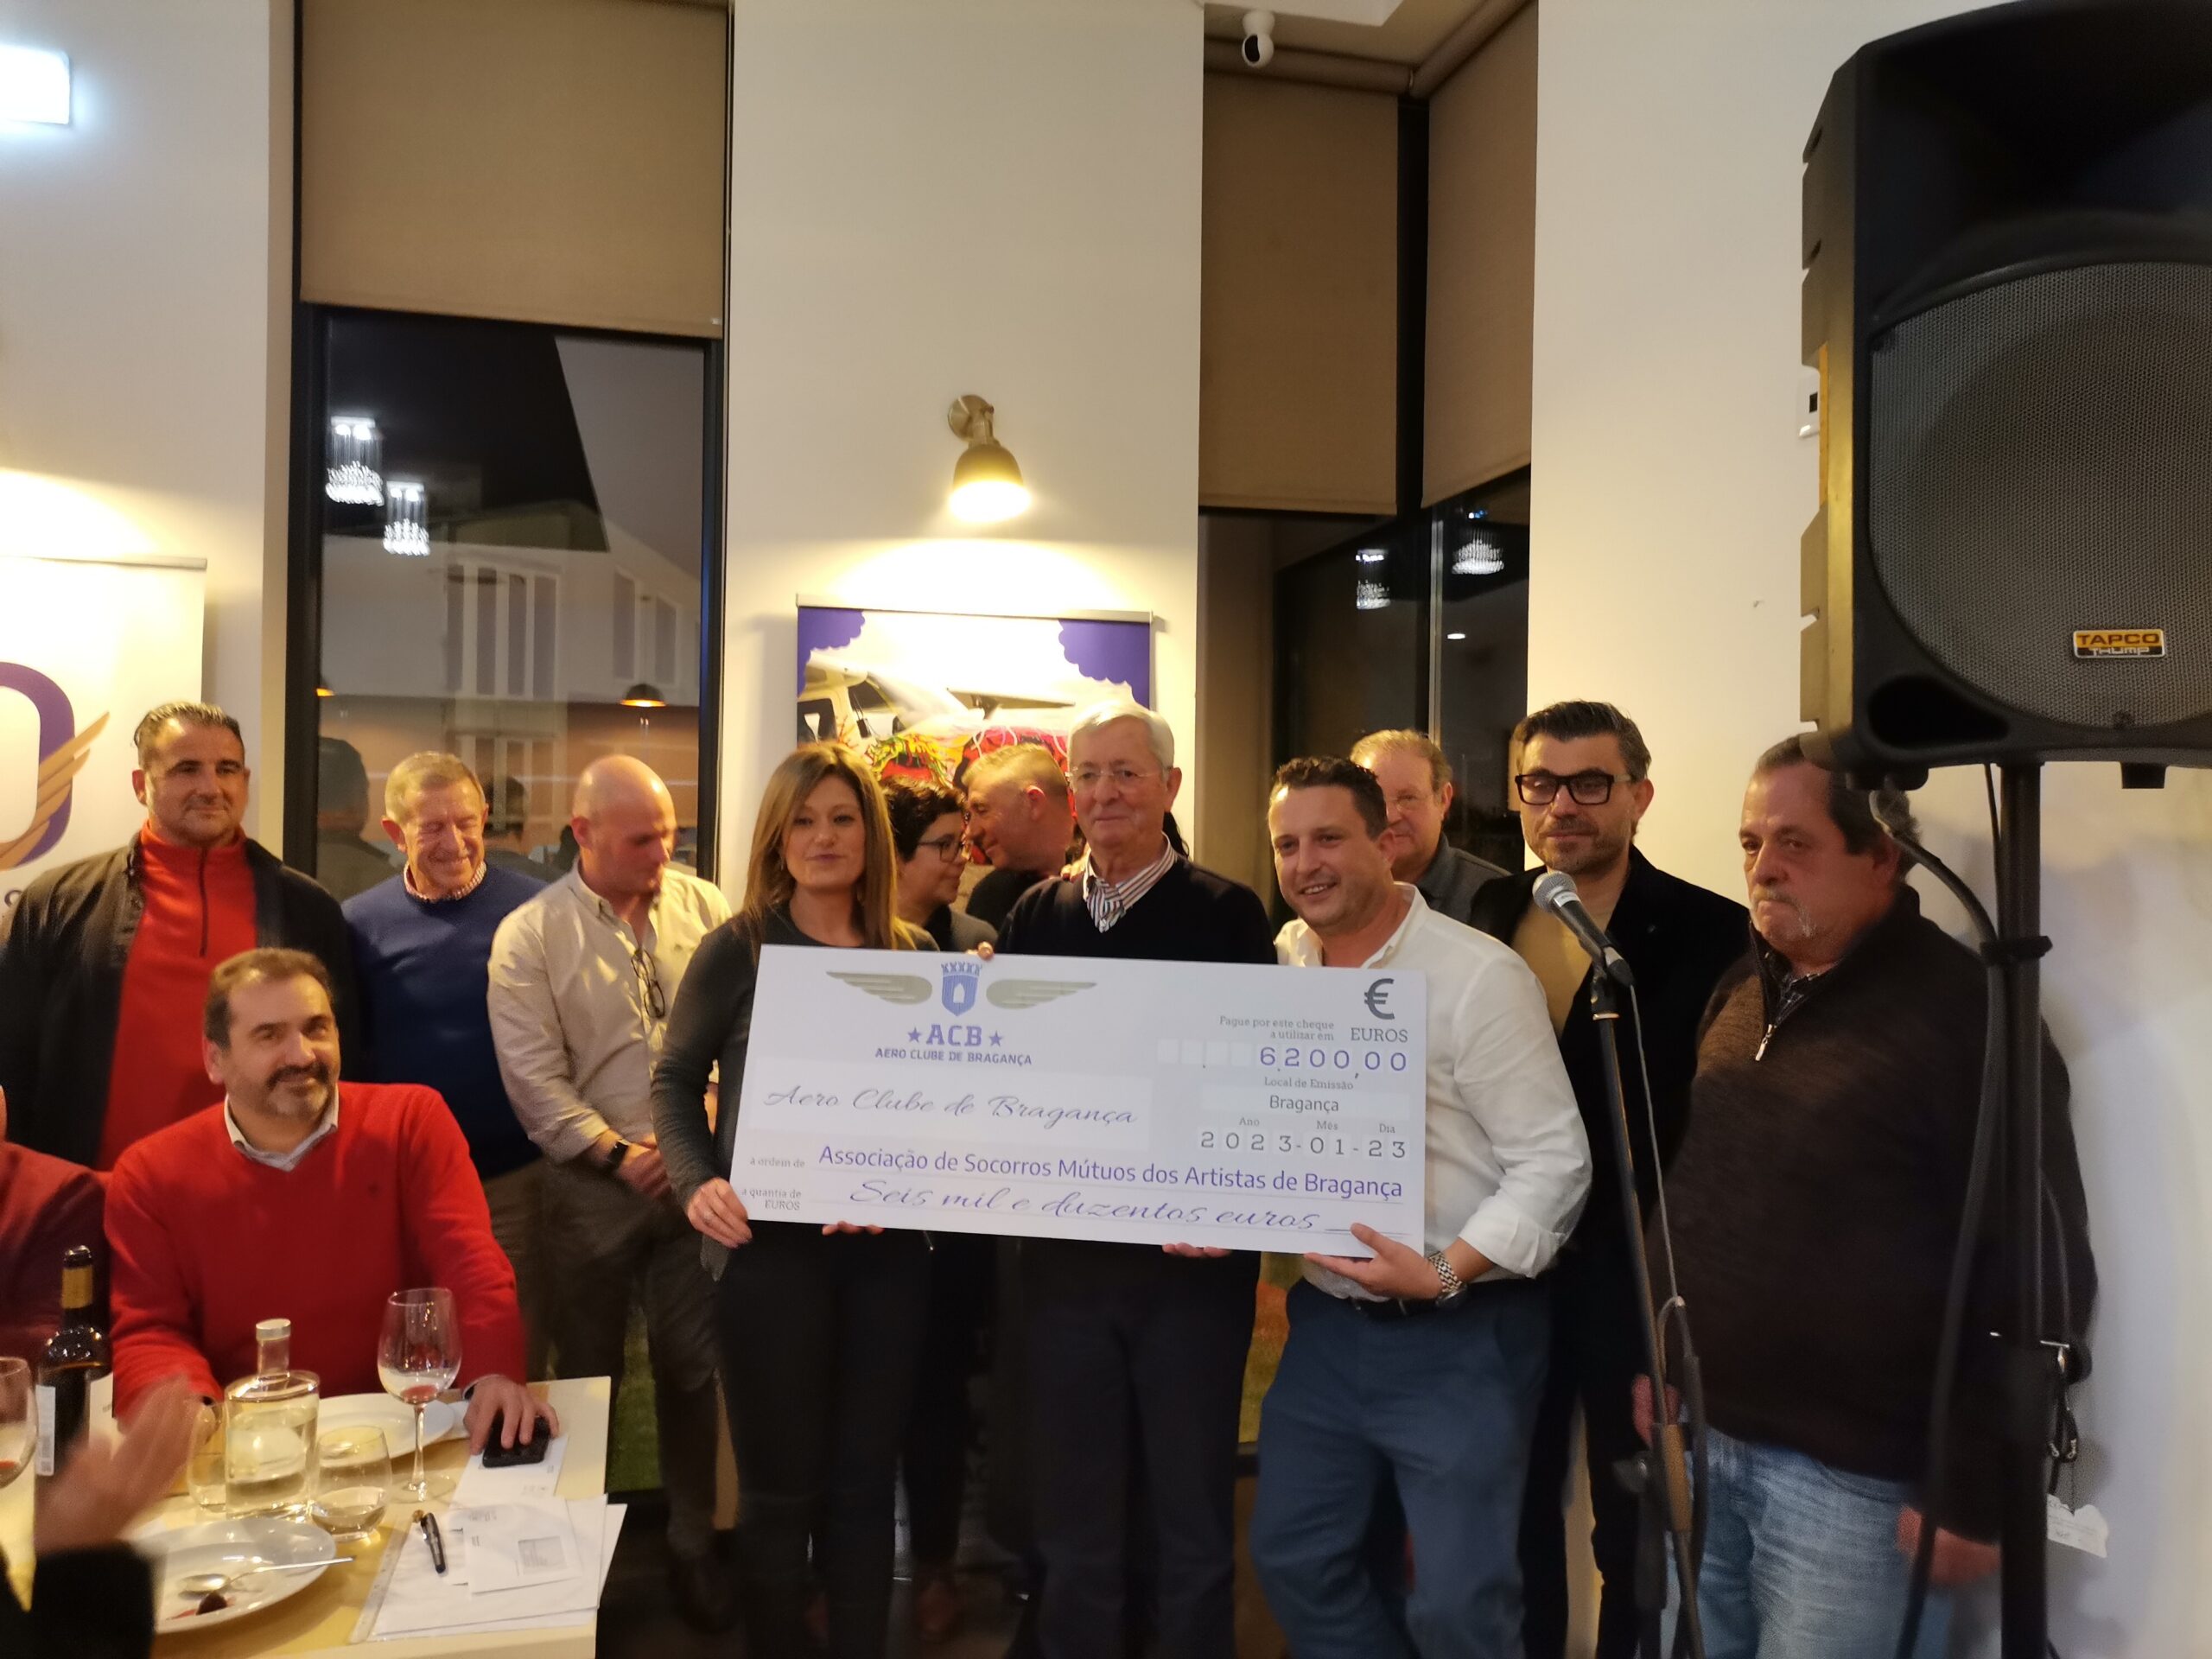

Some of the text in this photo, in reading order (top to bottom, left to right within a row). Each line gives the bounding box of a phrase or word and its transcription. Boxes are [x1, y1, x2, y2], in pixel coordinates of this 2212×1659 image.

[2076, 633, 2160, 645] TAPCO
[2089, 646, 2150, 656] THUMP
[1219, 1016, 1334, 1031] Pague por este cheque
[925, 1024, 982, 1047] ACB
[1280, 1031, 1315, 1040] utilizar
[1351, 1027, 1408, 1043] EUROS
[875, 1047, 1033, 1066] AERO CLUBE DE BRAGANÇA
[1264, 1077, 1354, 1090] Local de Emissão
[764, 1085, 1138, 1130] Aero Clube de Bragança
[1268, 1094, 1339, 1114] Bragança
[1239, 1116, 1260, 1127] Ano
[1316, 1121, 1338, 1131] Mês
[1379, 1123, 1395, 1134] Dia
[758, 1158, 791, 1167] ordem
[793, 1159, 804, 1167] de
[818, 1146, 1402, 1202] Associação de Socorros Mútuos dos Artistas de Bragança
[749, 1189, 787, 1198] quantia
[790, 1190, 802, 1199] de
[765, 1199, 800, 1211] EUROS
[850, 1180, 1319, 1230] Seis mil e duzentos euros
